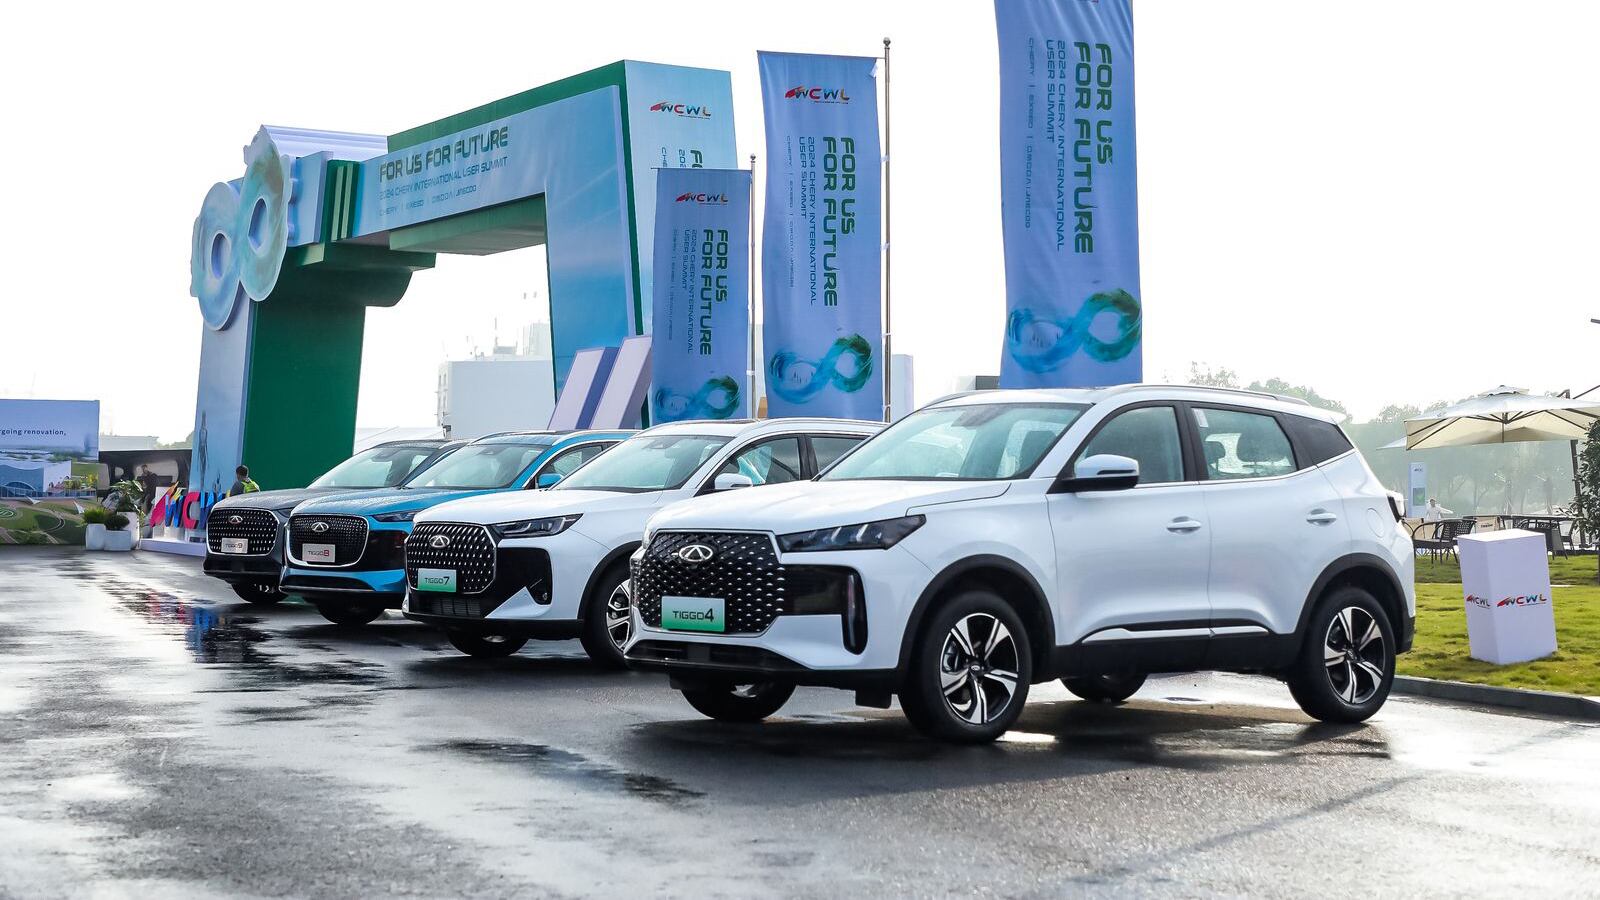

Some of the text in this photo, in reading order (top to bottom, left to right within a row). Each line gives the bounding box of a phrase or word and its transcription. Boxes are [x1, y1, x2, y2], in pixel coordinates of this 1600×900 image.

[1046, 39, 1055, 144] USER SUMMIT
[1095, 43, 1113, 165] FOR US
[380, 126, 508, 182] FOR US FOR FUTURE
[414, 171, 462, 193] INTERNATIONAL
[480, 156, 508, 173] SUMMIT
[799, 136, 808, 220] USER SUMMIT
[841, 136, 857, 234] FOR US
[1056, 40, 1066, 253] 2024 CHERY INTERNATIONAL
[1074, 41, 1098, 254] FOR FUTURE
[681, 255, 689, 290] SUMMIT
[715, 229, 729, 302] FOR US
[807, 136, 817, 306] 2024 CHERY INTERNATIONAL
[822, 136, 840, 307] FOR FUTURE
[687, 229, 698, 354] 2024 CHERY INTERNATIONAL
[699, 229, 714, 355] FOR FUTURE
[672, 608, 715, 622] TIGGO4
